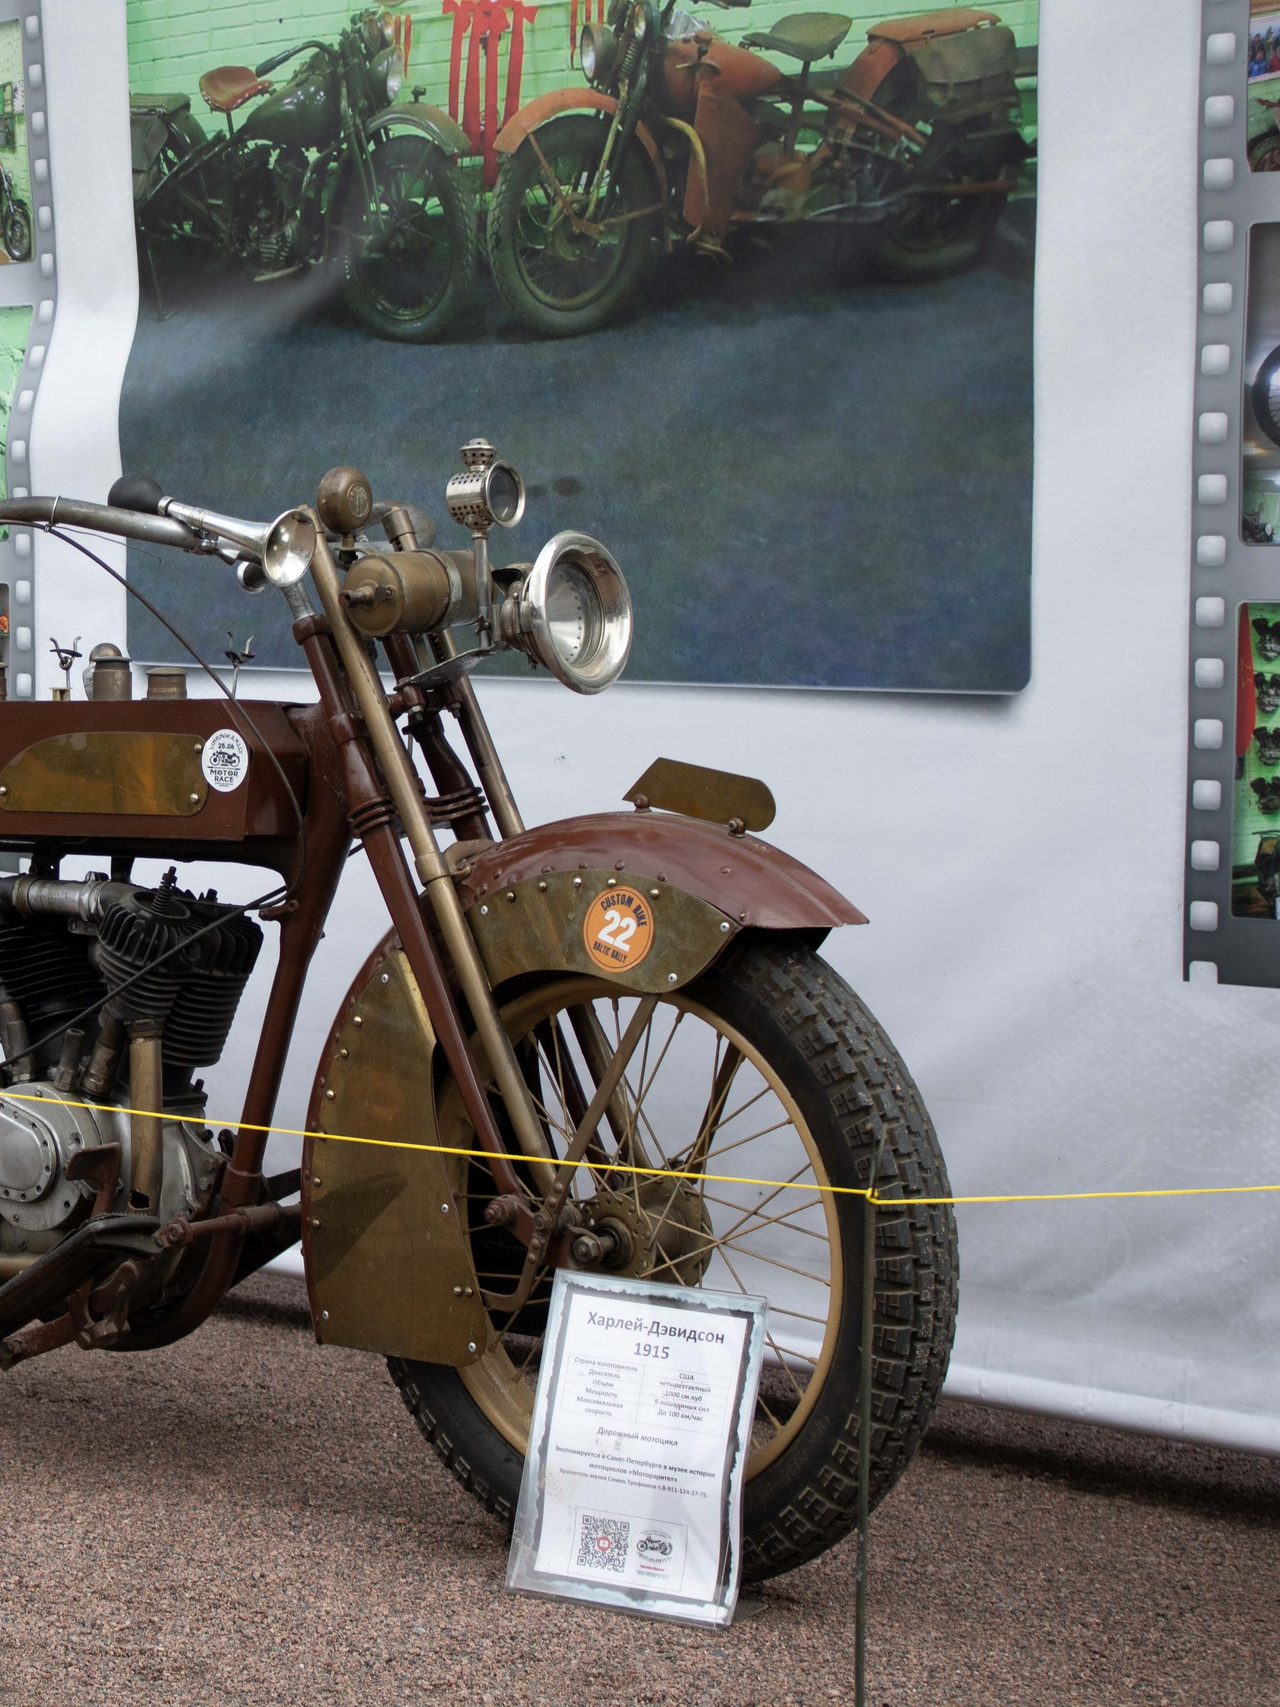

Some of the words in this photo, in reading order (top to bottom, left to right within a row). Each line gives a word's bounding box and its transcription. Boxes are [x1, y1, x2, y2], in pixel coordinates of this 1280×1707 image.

[210, 769, 239, 778] MOTOR
[214, 775, 234, 783] RACE
[600, 893, 634, 911] CUSTOM
[632, 904, 648, 928] BIKE
[597, 909, 637, 952] 22
[593, 940, 611, 956] BALTIC
[610, 949, 628, 964] RALLY
[587, 1311, 725, 1344] Харлей-Дэвидсон
[633, 1342, 670, 1360] 1915
[574, 1356, 596, 1365] Страна
[597, 1362, 639, 1372] изготовитель
[588, 1368, 621, 1379] Двигатель
[679, 1373, 695, 1381] США
[592, 1379, 614, 1388] Объем
[659, 1380, 712, 1393] четырехтактный
[585, 1387, 618, 1398] Мощность
[665, 1390, 680, 1398] 1000
[681, 1394, 703, 1403] см.куб
[576, 1395, 624, 1409] Максимальная
[660, 1400, 697, 1412] лошадиных
[585, 1407, 612, 1417] скорость
[669, 1410, 680, 1418] 100
[681, 1413, 703, 1421] км/час
[597, 1427, 639, 1440] Дорожный
[640, 1436, 678, 1447] мотоцикл
[555, 1445, 601, 1458] Экспонируется
[607, 1454, 663, 1469] Санкт-Петербурге
[668, 1465, 688, 1474] музее
[688, 1469, 716, 1478] истории
[560, 1467, 589, 1478] Хранитель
[589, 1473, 607, 1481] музея
[607, 1475, 627, 1484] Семен
[627, 1479, 657, 1490] Трофимов
[589, 1463, 627, 1475] мотоциклов
[628, 1469, 678, 1482] «Мотораритет»
